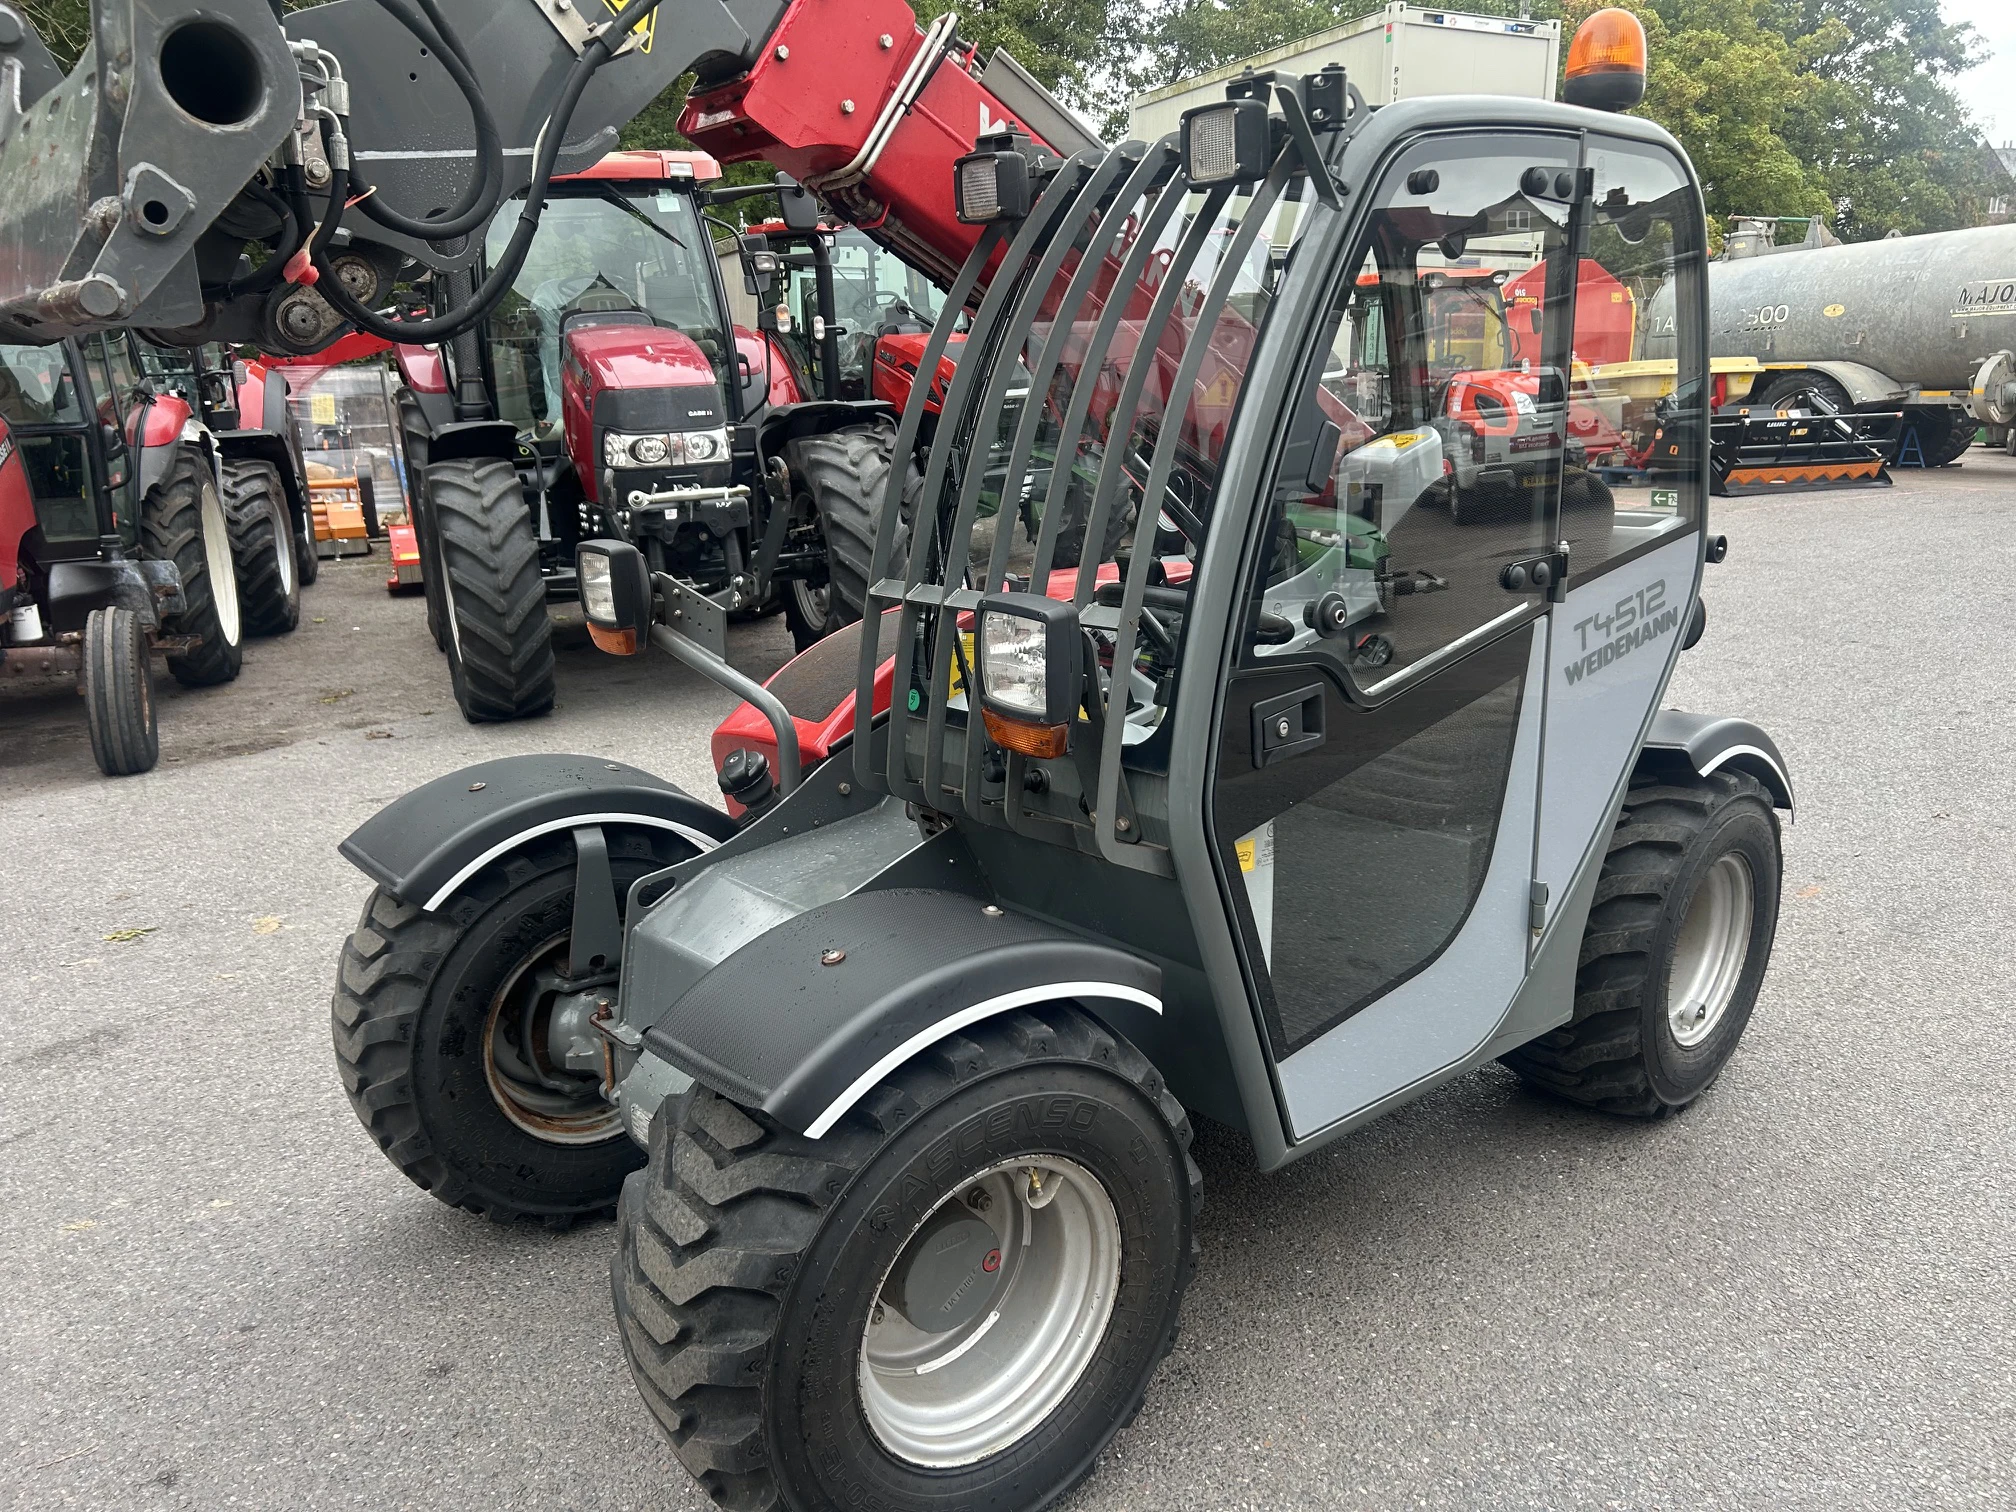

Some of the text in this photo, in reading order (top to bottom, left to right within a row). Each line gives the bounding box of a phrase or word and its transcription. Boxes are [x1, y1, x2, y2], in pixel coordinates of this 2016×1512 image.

[1737, 304, 1789, 326] 500
[1958, 284, 2016, 305] MAJO
[1564, 606, 1678, 686] WEIDEMANN
[1573, 579, 1666, 651] T4512
[901, 1098, 1100, 1204] ASCENSO
